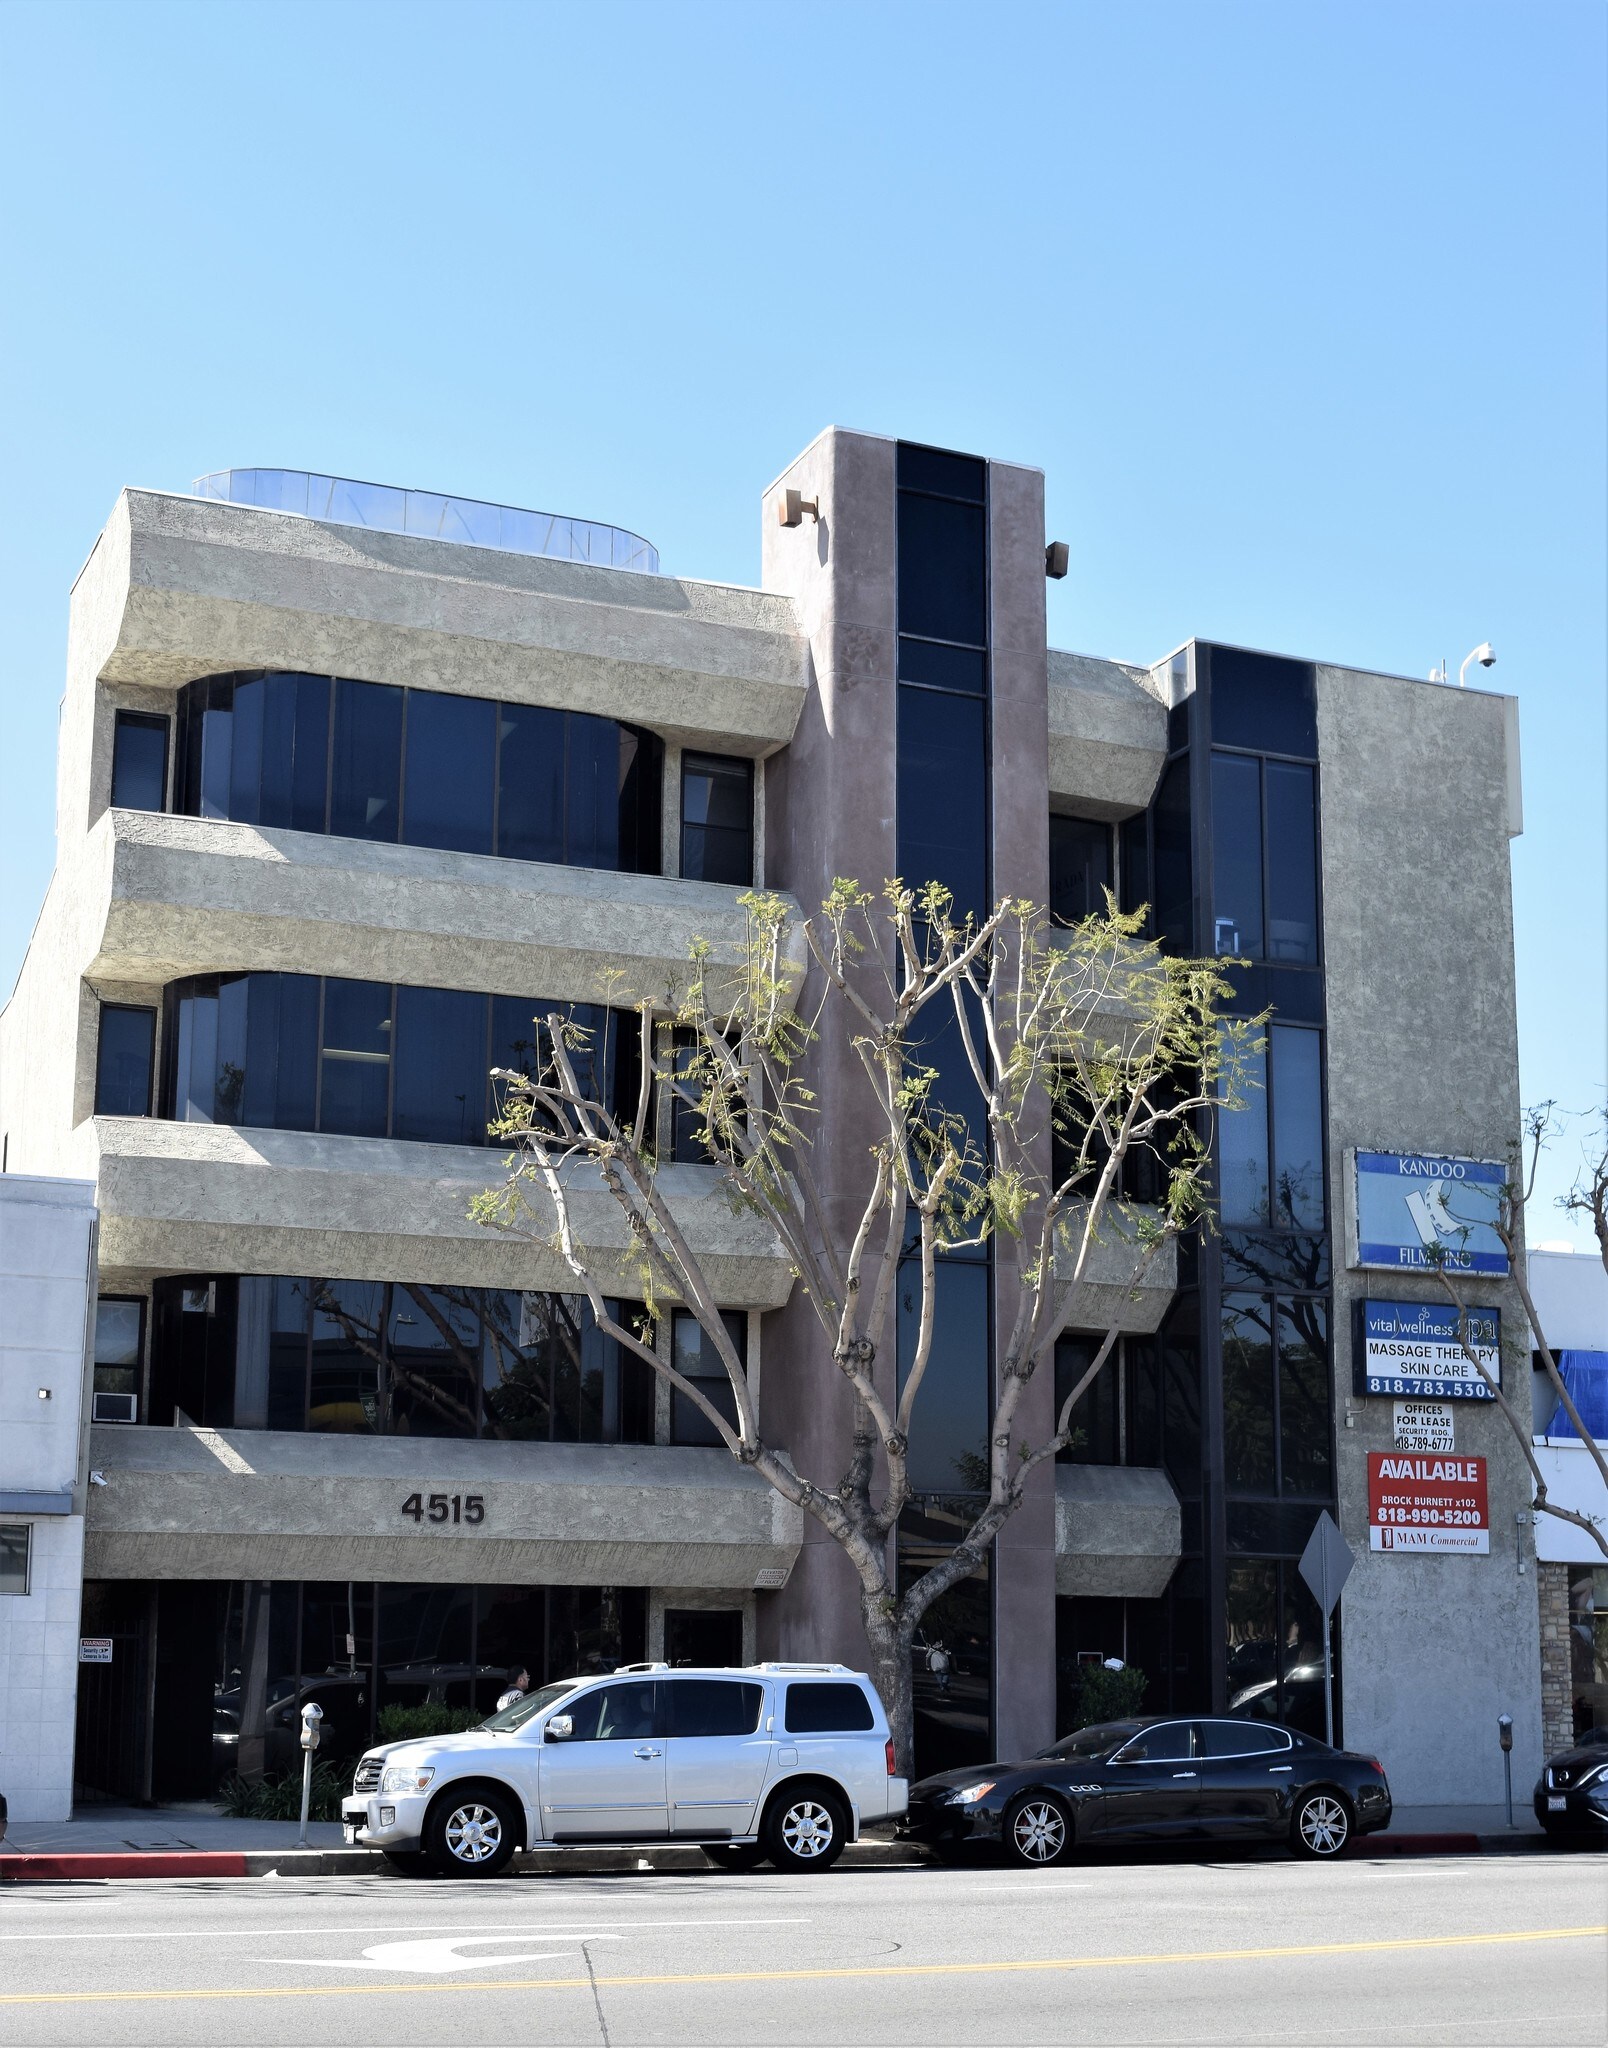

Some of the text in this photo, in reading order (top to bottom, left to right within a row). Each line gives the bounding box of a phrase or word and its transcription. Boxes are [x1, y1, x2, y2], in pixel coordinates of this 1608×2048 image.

[1399, 1158, 1466, 1179] KANDOO
[1369, 1318, 1396, 1332] vital
[1400, 1321, 1454, 1336] wellness
[1369, 1342, 1495, 1362] MASSAGE THERPY
[1400, 1361, 1468, 1377] SKIN CARE
[1405, 1404, 1443, 1415] OFFICES
[1396, 1416, 1451, 1427] FOR LEASE
[1398, 1427, 1450, 1437] SECURITY BLDG.
[1378, 1459, 1478, 1483] AVAILABLE
[401, 1493, 485, 1524] 4515
[1382, 1495, 1476, 1508] BROCK BURNETT x102
[1377, 1507, 1481, 1525] 818-990-5200
[1397, 1532, 1479, 1547] MAM Commercial
